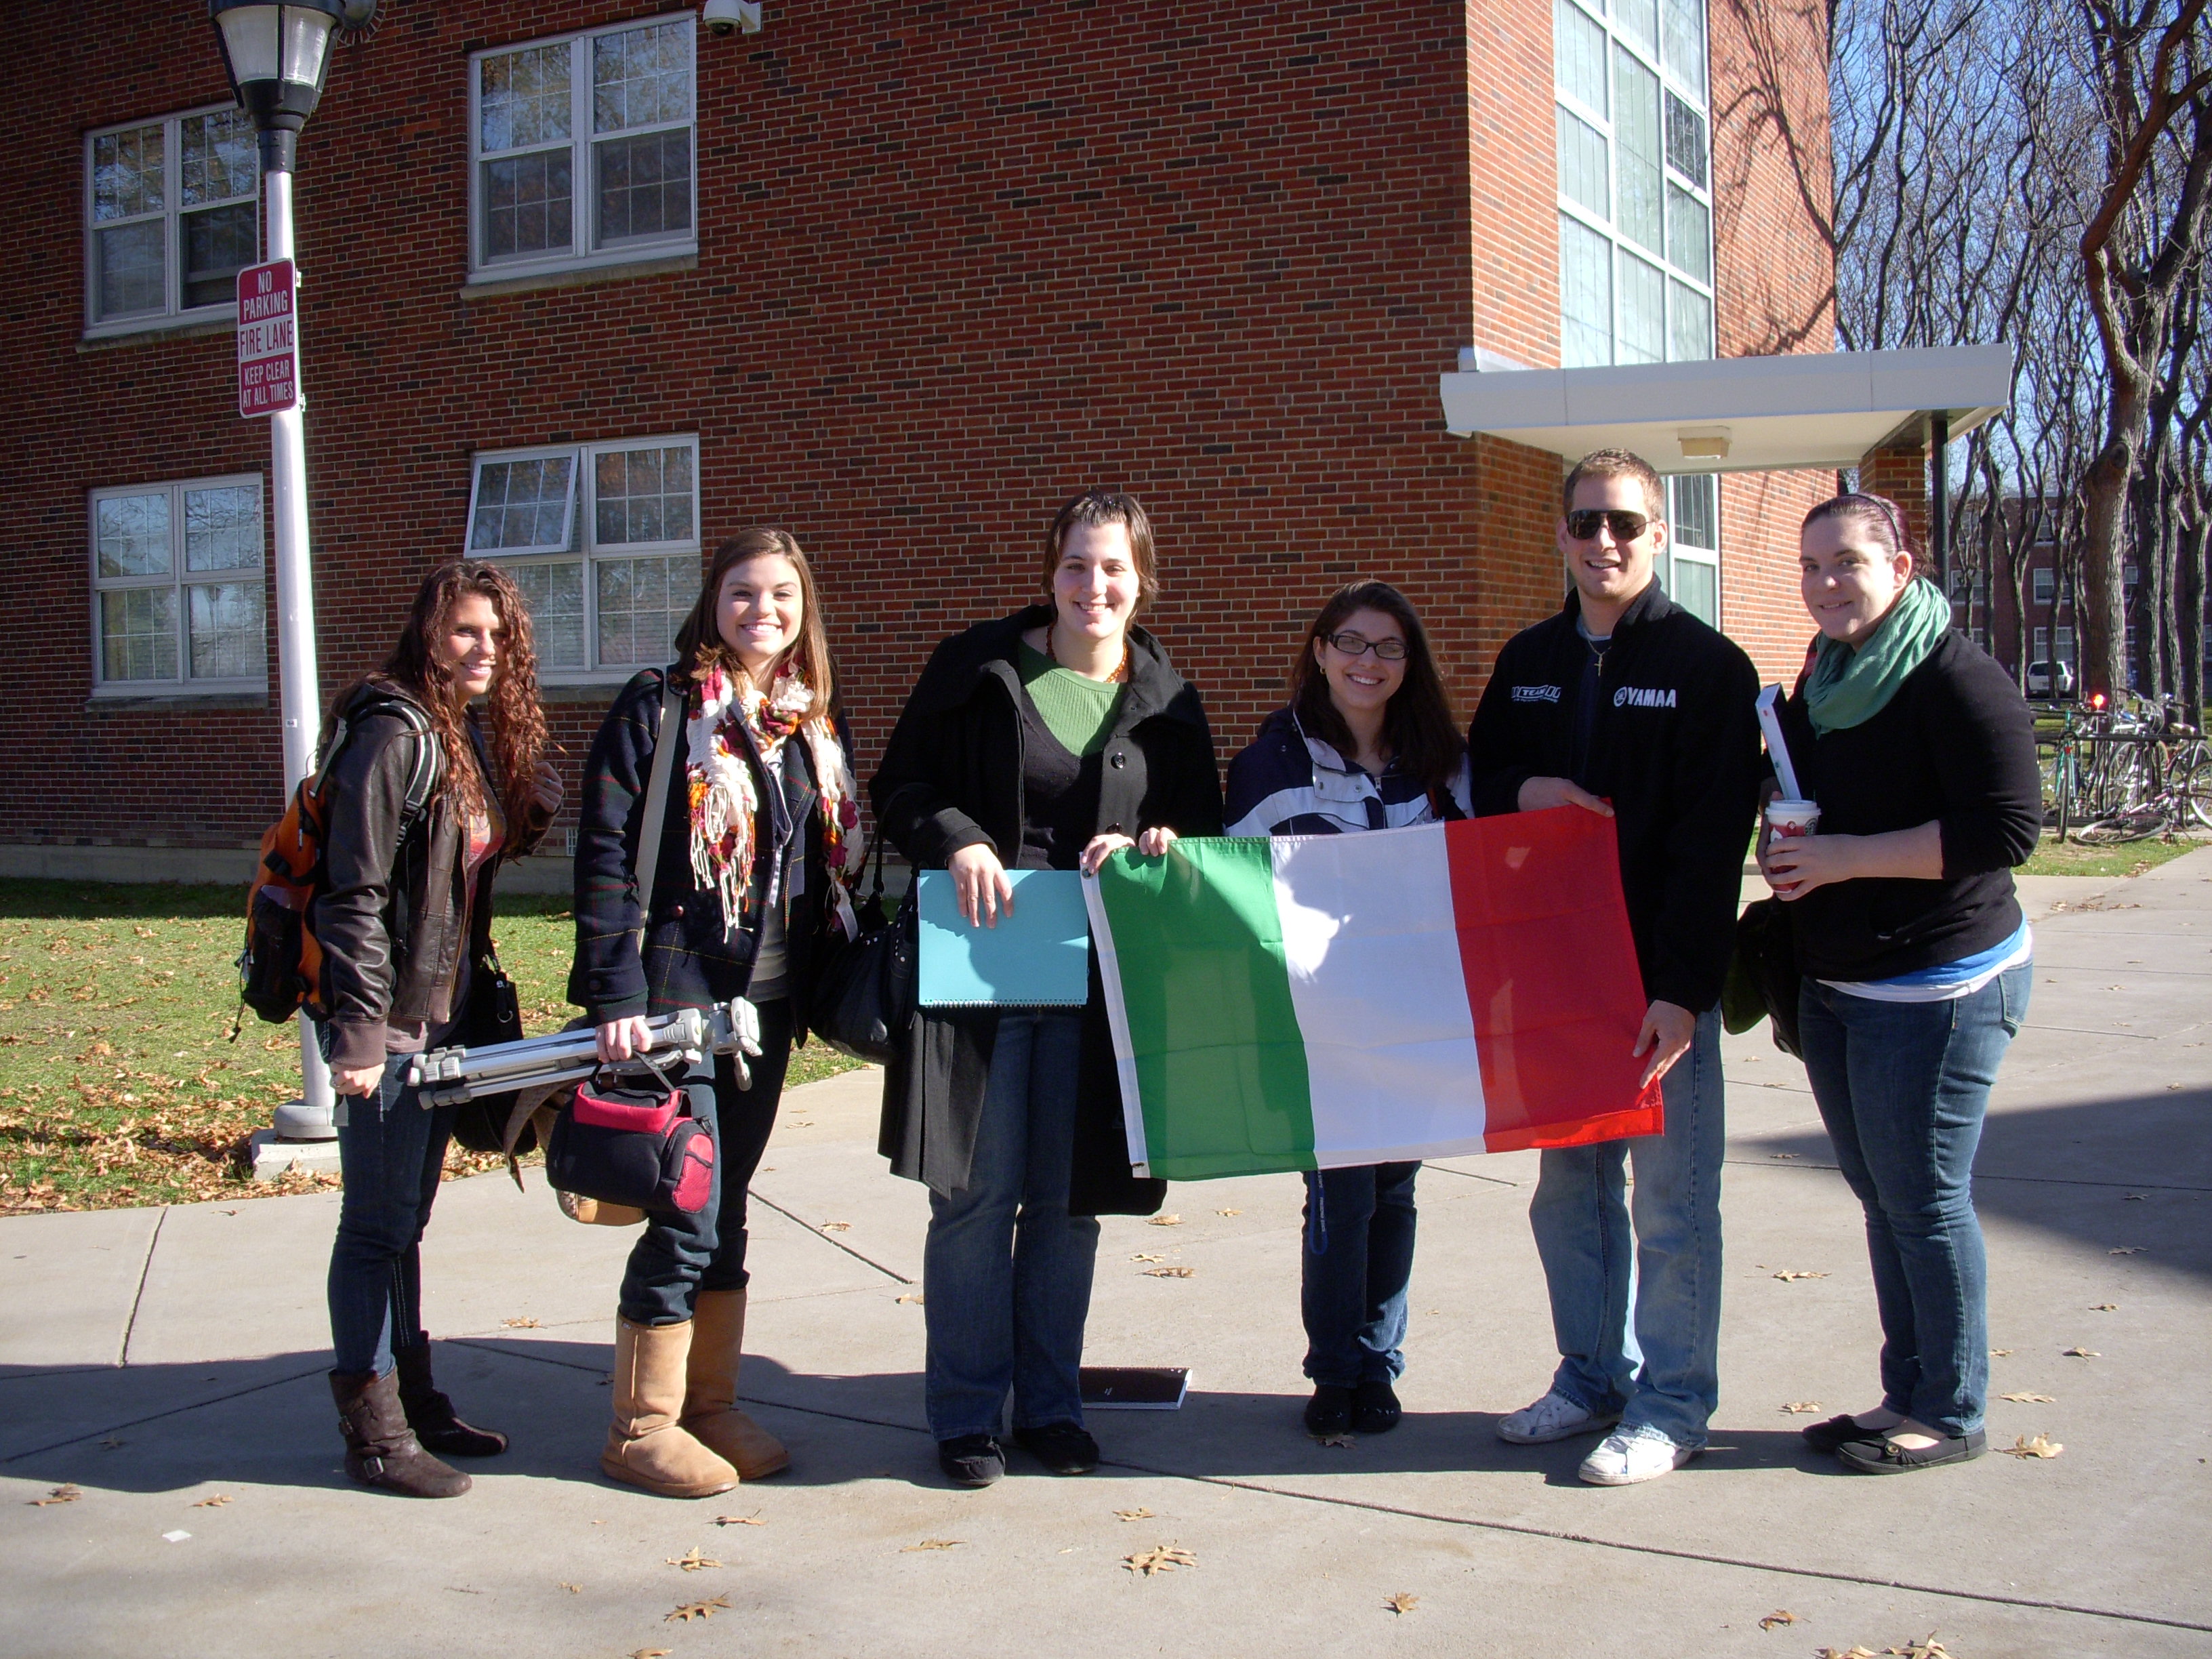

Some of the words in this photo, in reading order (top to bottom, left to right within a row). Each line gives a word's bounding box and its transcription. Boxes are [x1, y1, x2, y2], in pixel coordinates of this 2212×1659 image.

[258, 270, 272, 294] NO
[243, 290, 288, 321] PARKING
[240, 327, 261, 356] FIRE
[266, 319, 293, 351] LANE
[245, 365, 263, 386] KEEP
[266, 361, 289, 381] CLEAR
[243, 390, 251, 408] AT
[255, 387, 267, 405] ALL
[270, 381, 293, 401] TIMES
[1627, 687, 1677, 708] YAMAA
